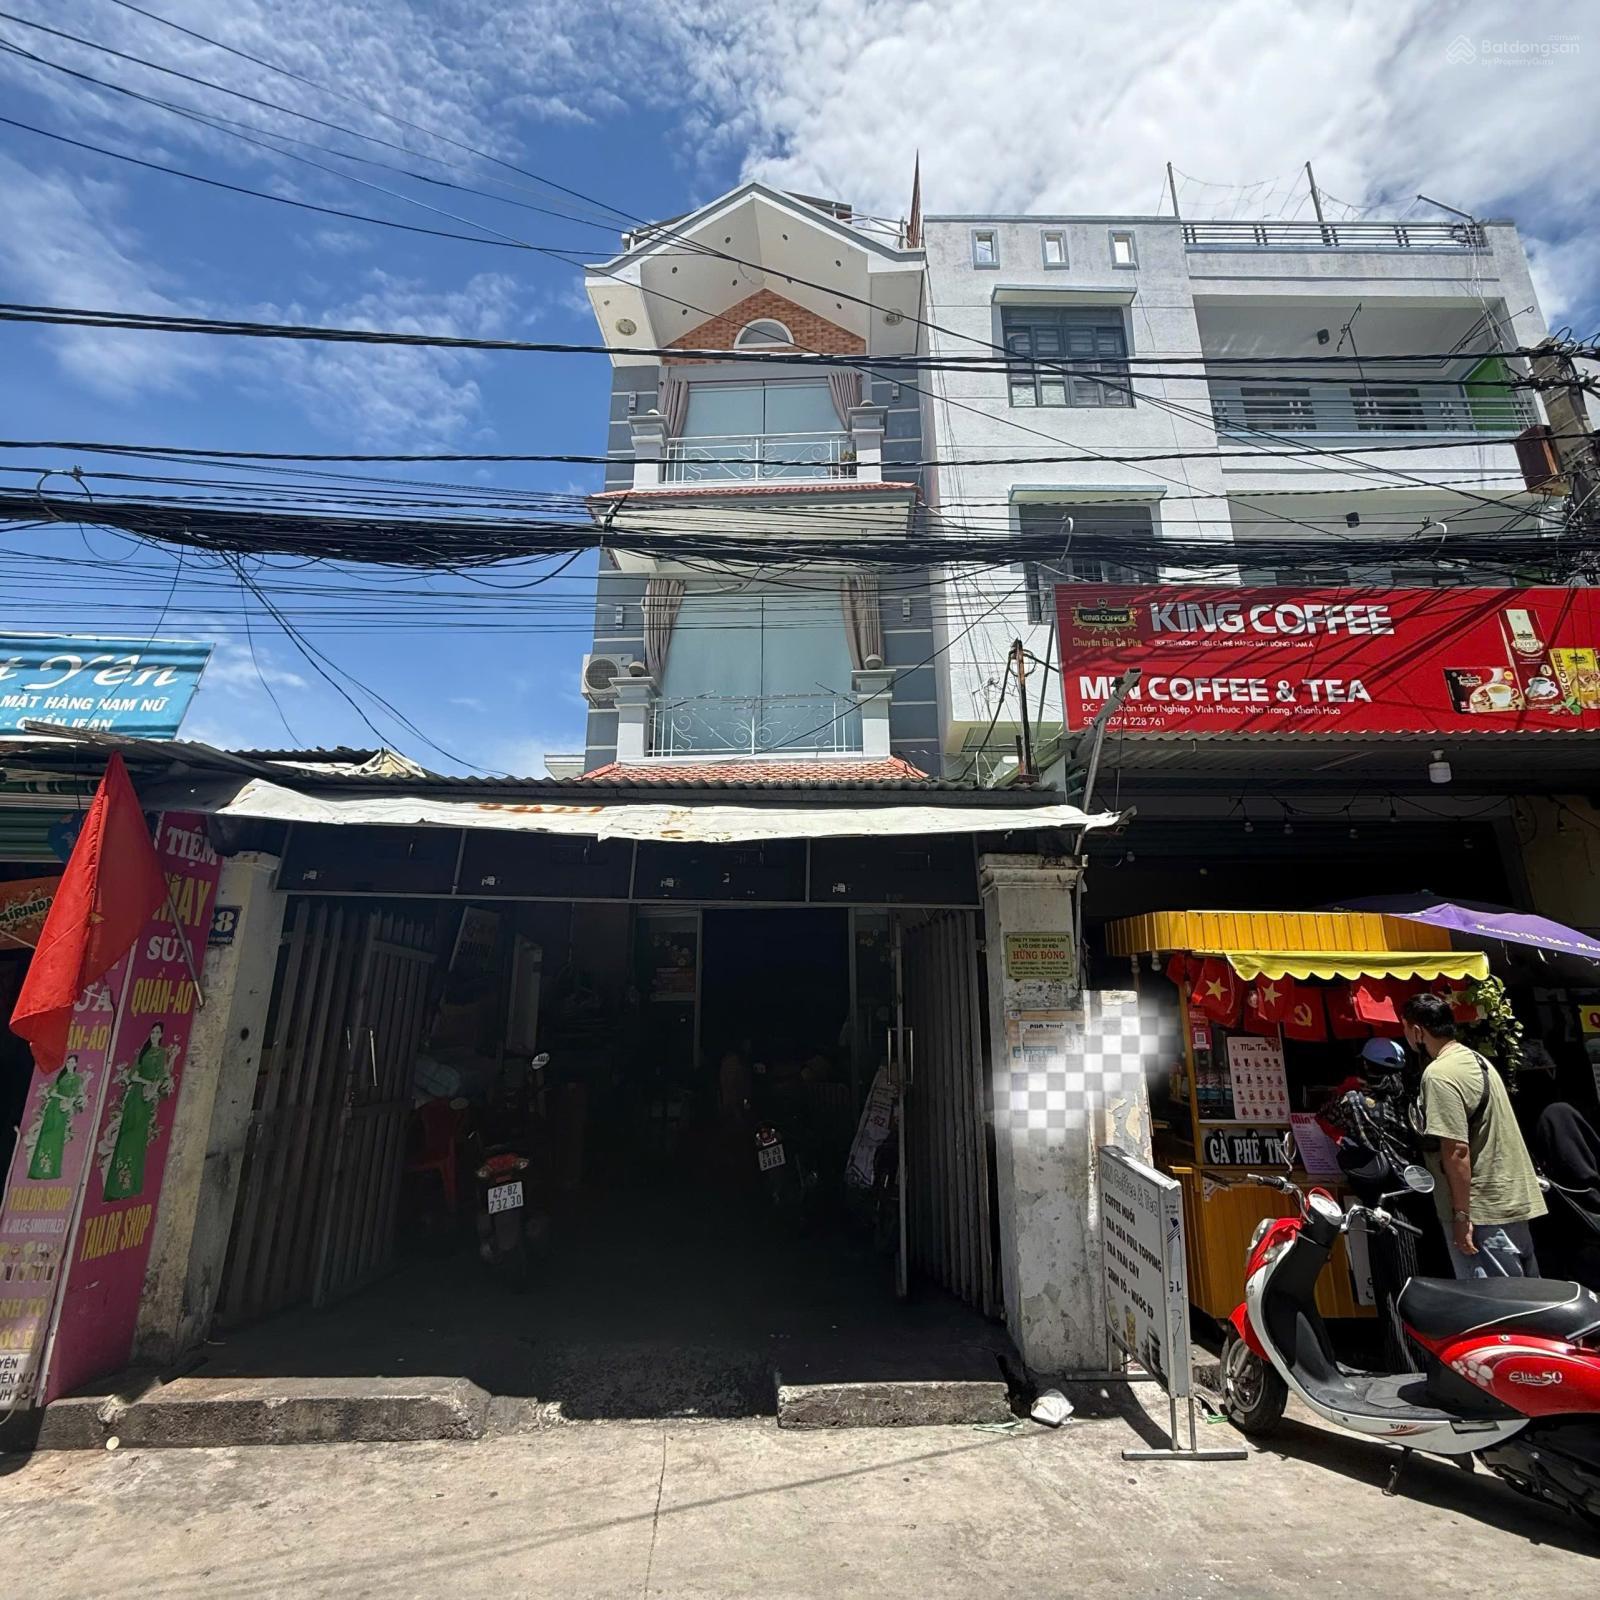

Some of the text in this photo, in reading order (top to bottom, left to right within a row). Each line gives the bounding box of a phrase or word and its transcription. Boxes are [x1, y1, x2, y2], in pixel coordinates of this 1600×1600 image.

[1151, 602, 1395, 635] KING COFFEE
[1148, 677, 1269, 701] COFFEE
[1276, 680, 1296, 702] &
[1301, 679, 1373, 702] TEA
[43, 693, 94, 711] HÀNG
[97, 698, 136, 711] NAM
[140, 695, 170, 712] NỮ
[1130, 717, 1147, 726] 228
[1149, 717, 1165, 726] 761
[211, 911, 235, 932] 8
[1234, 1130, 1262, 1164] PHÊ
[80, 1204, 153, 1262] TAILOR SHOP
[1541, 1371, 1563, 1385] 50
